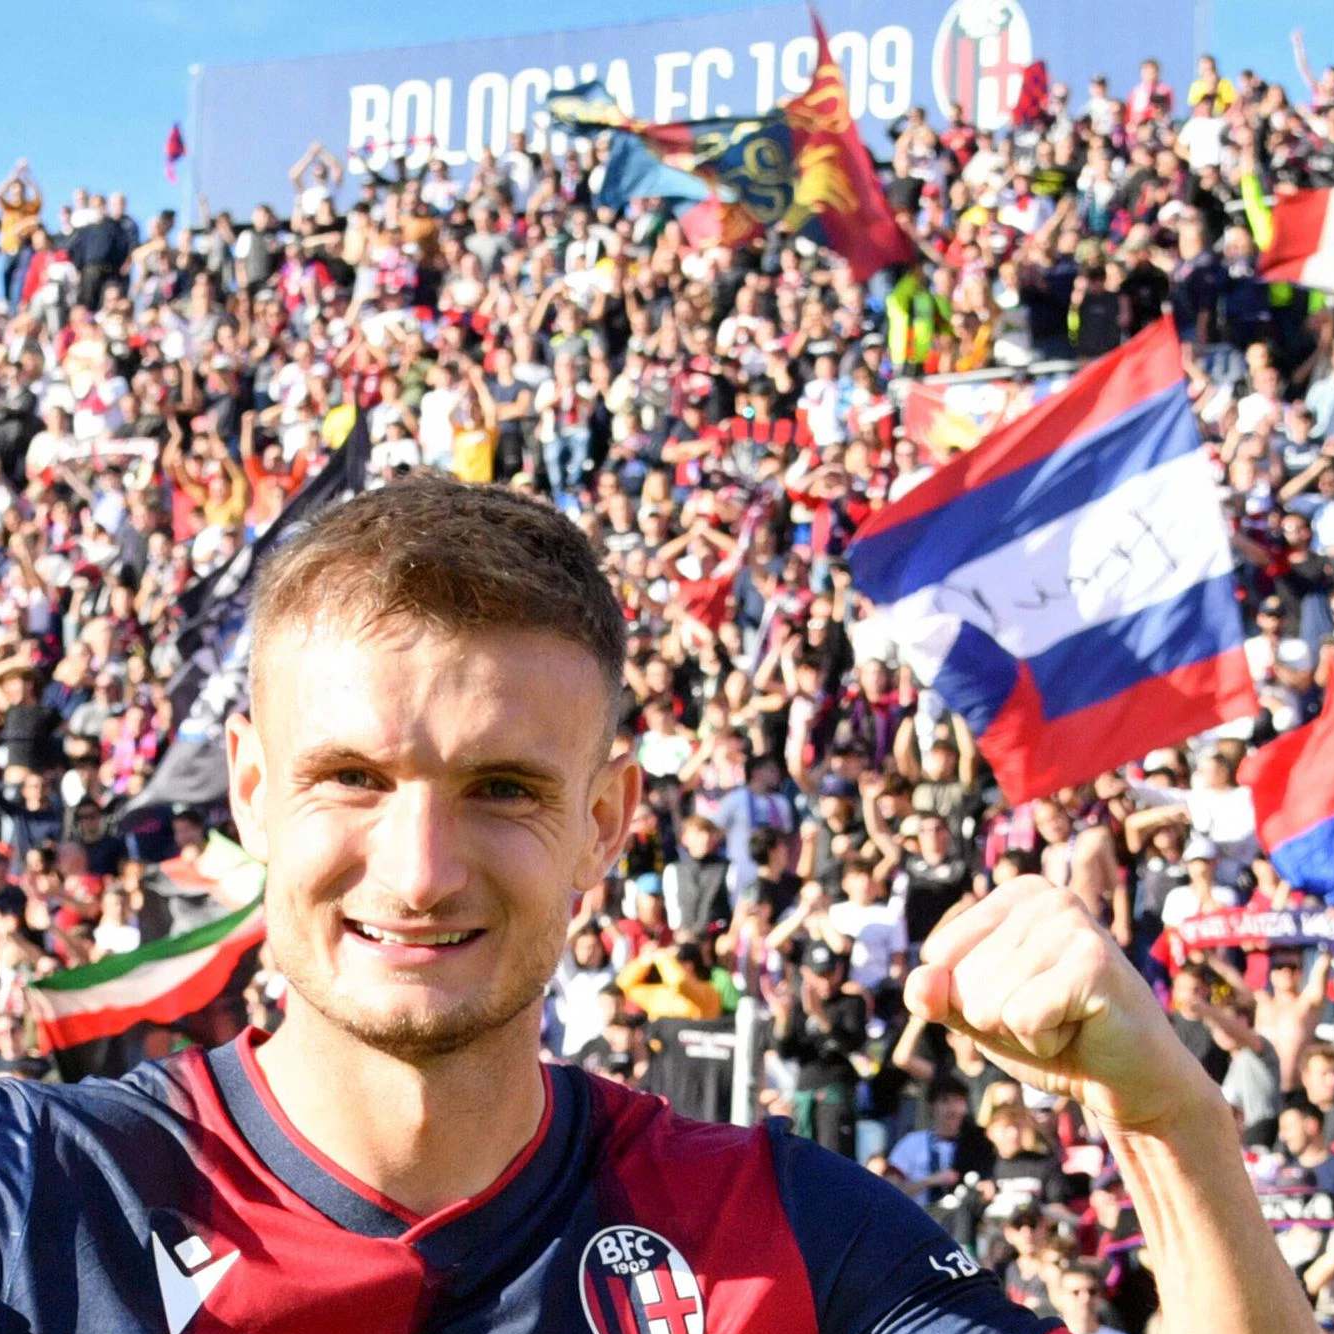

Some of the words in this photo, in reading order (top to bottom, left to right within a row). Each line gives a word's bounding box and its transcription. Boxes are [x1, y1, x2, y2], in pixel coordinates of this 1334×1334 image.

[654, 48, 734, 124] FC
[749, 25, 913, 124] 1909
[596, 1231, 655, 1265] BFC
[612, 1258, 650, 1275] 1909
